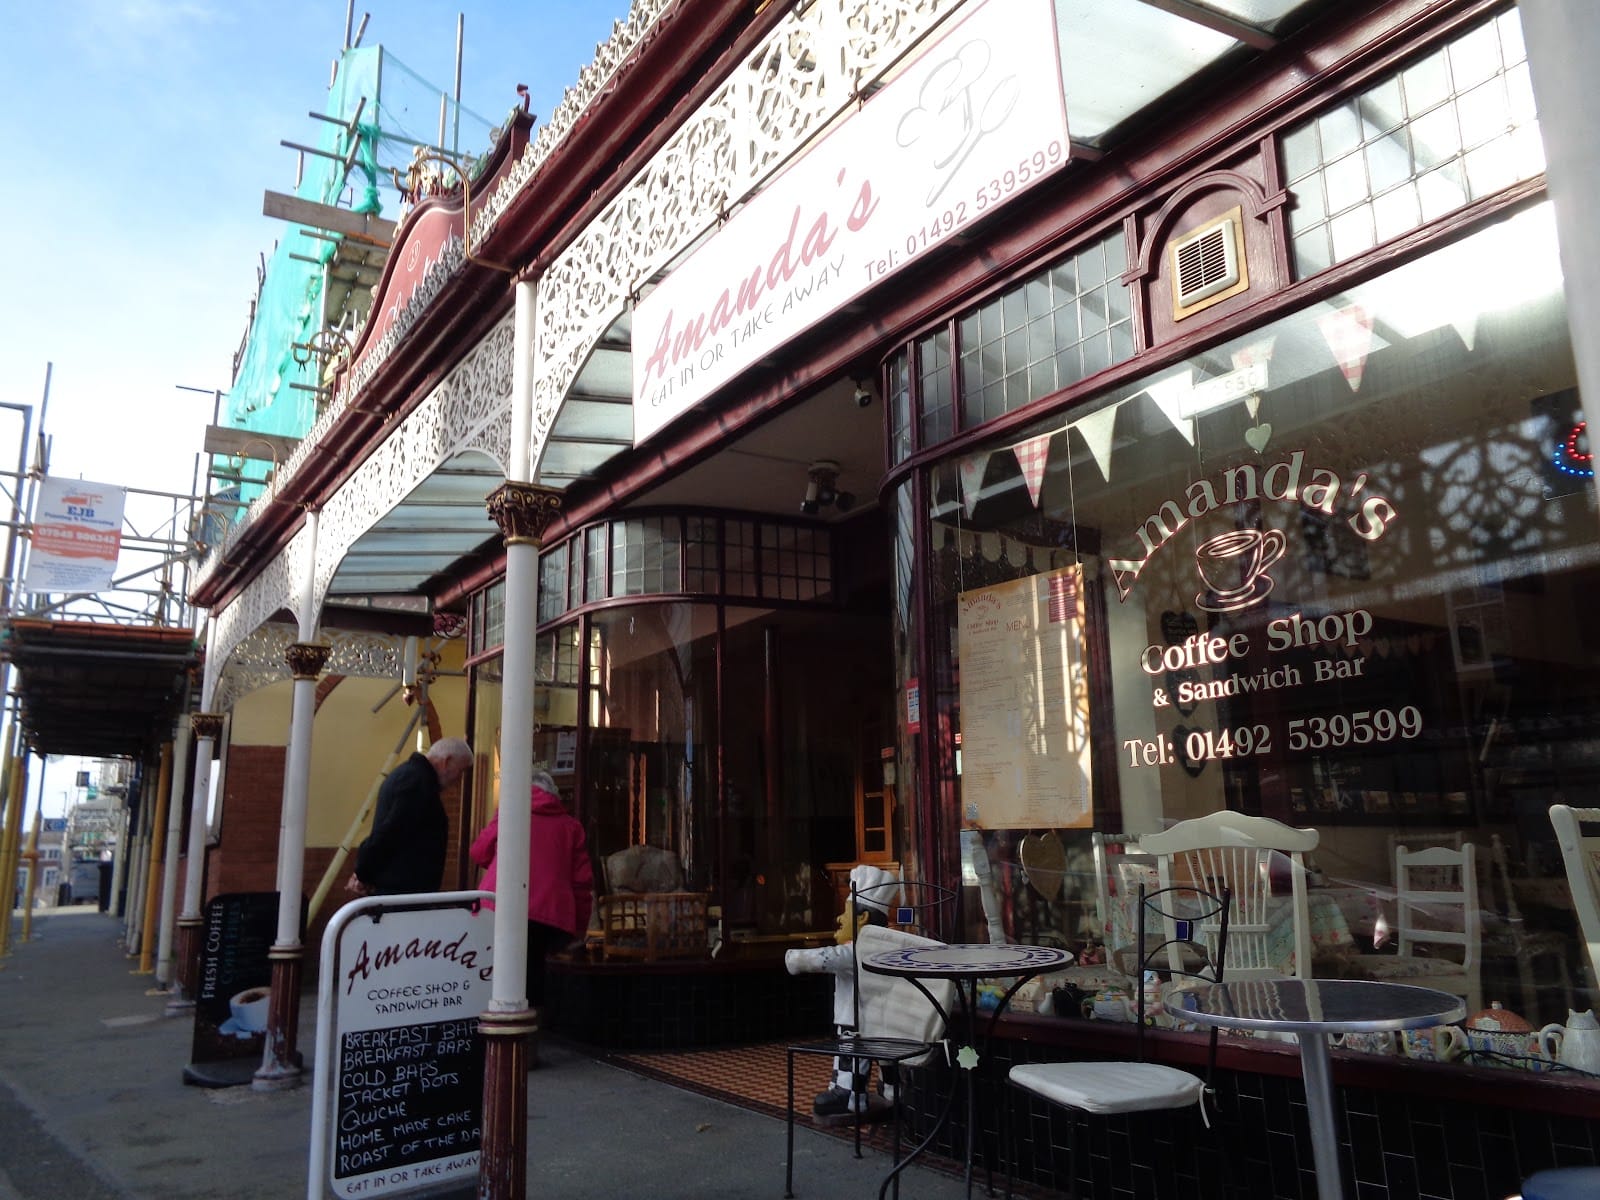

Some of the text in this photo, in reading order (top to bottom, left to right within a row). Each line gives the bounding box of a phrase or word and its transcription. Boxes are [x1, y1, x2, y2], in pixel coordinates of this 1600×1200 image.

[864, 140, 1062, 282] Tel: 01492 539599
[640, 167, 881, 399] Amanda's
[651, 254, 845, 407] EAT IN OR TAKE AWAY
[1108, 450, 1398, 603] Amanda's
[1140, 608, 1373, 675] Coffee Shop
[1153, 655, 1366, 707] & Sandwich Bar
[1123, 705, 1423, 768] Tel: 01492 539599
[202, 903, 224, 999] FRESH COFFEE
[347, 932, 493, 996] Amanda's
[367, 985, 422, 1001] COFFEE
[425, 981, 459, 995] SHOP
[375, 996, 463, 1014] SANDWICH BAR
[344, 1039, 473, 1071] BREAKFAST BAPS
[345, 1024, 437, 1049] BREAKFAST
[343, 1060, 439, 1088] COLD BAPS
[344, 1072, 459, 1111] JACKET POTS
[340, 1110, 472, 1150] HOME MADE CAKE
[340, 1128, 481, 1173] ROAST OF THE DA
[346, 1154, 481, 1194] EAT IN OR TAKE AWAY
